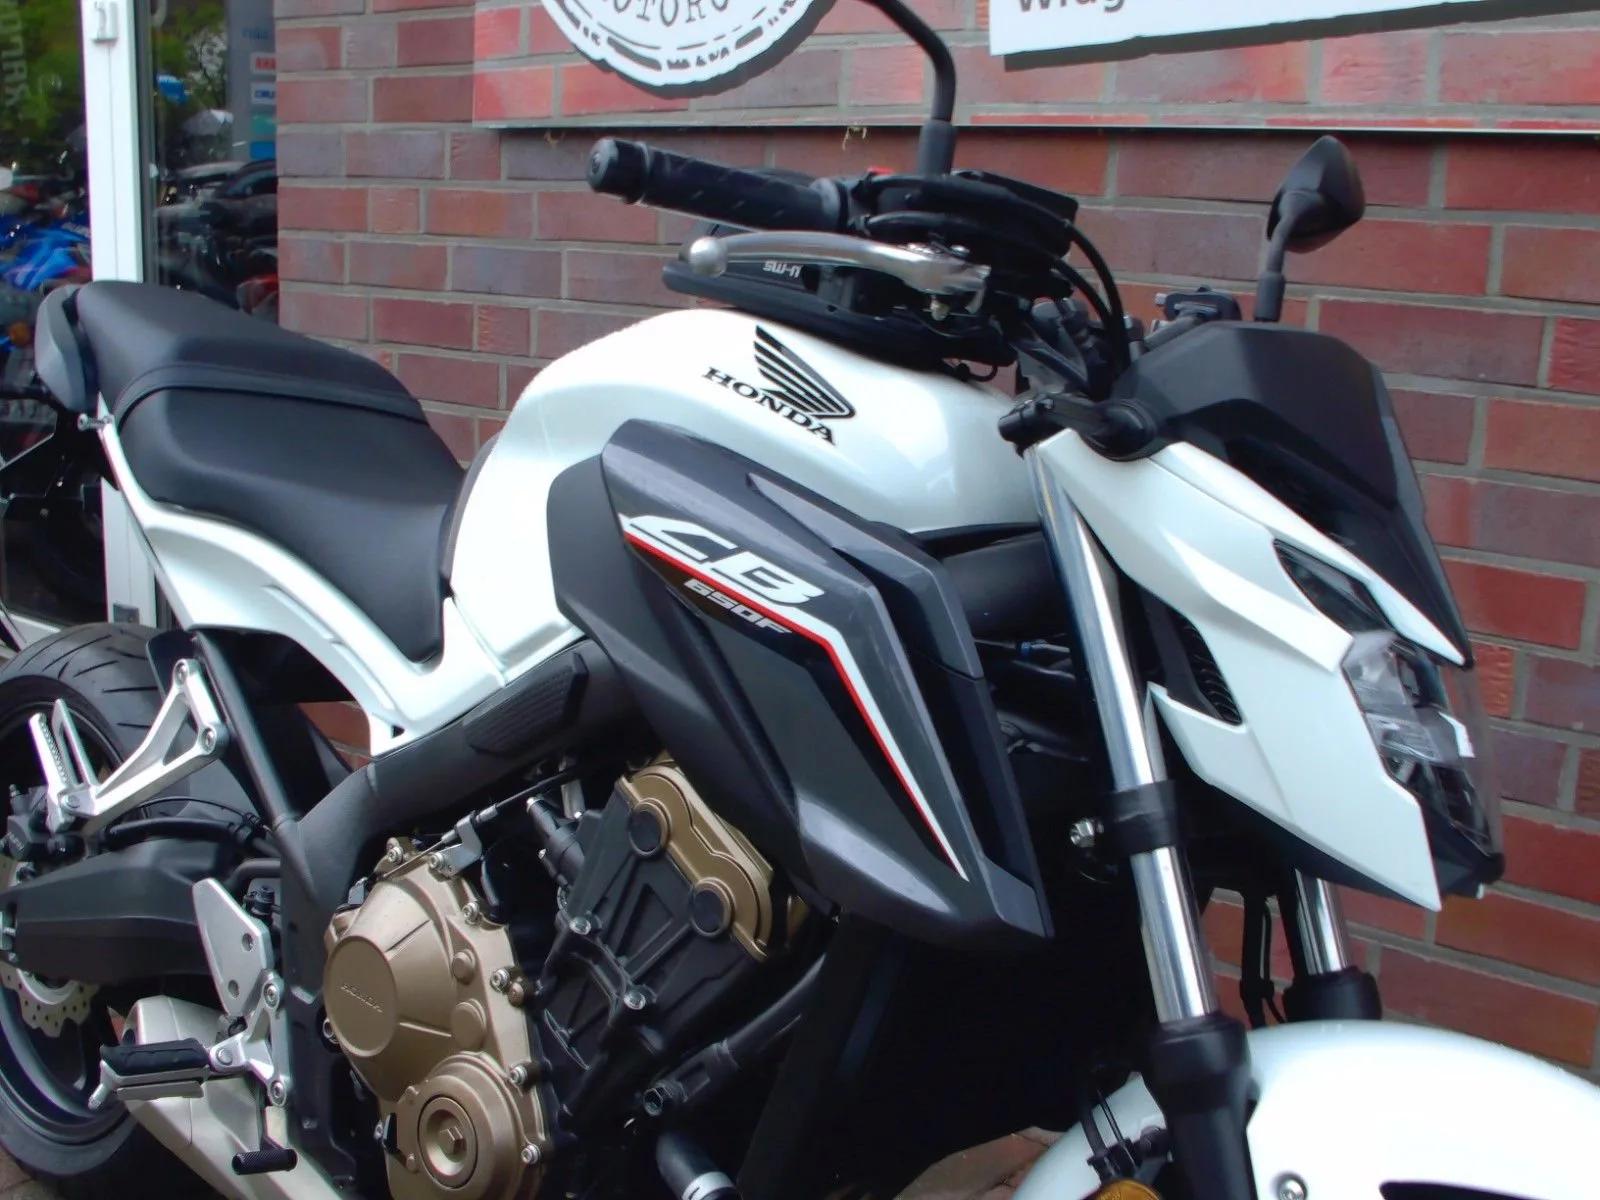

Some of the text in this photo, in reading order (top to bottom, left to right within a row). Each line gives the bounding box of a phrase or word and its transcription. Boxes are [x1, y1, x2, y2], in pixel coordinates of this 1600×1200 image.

[702, 366, 836, 446] HONDA
[626, 514, 826, 605] CB
[684, 578, 793, 634] 650F
